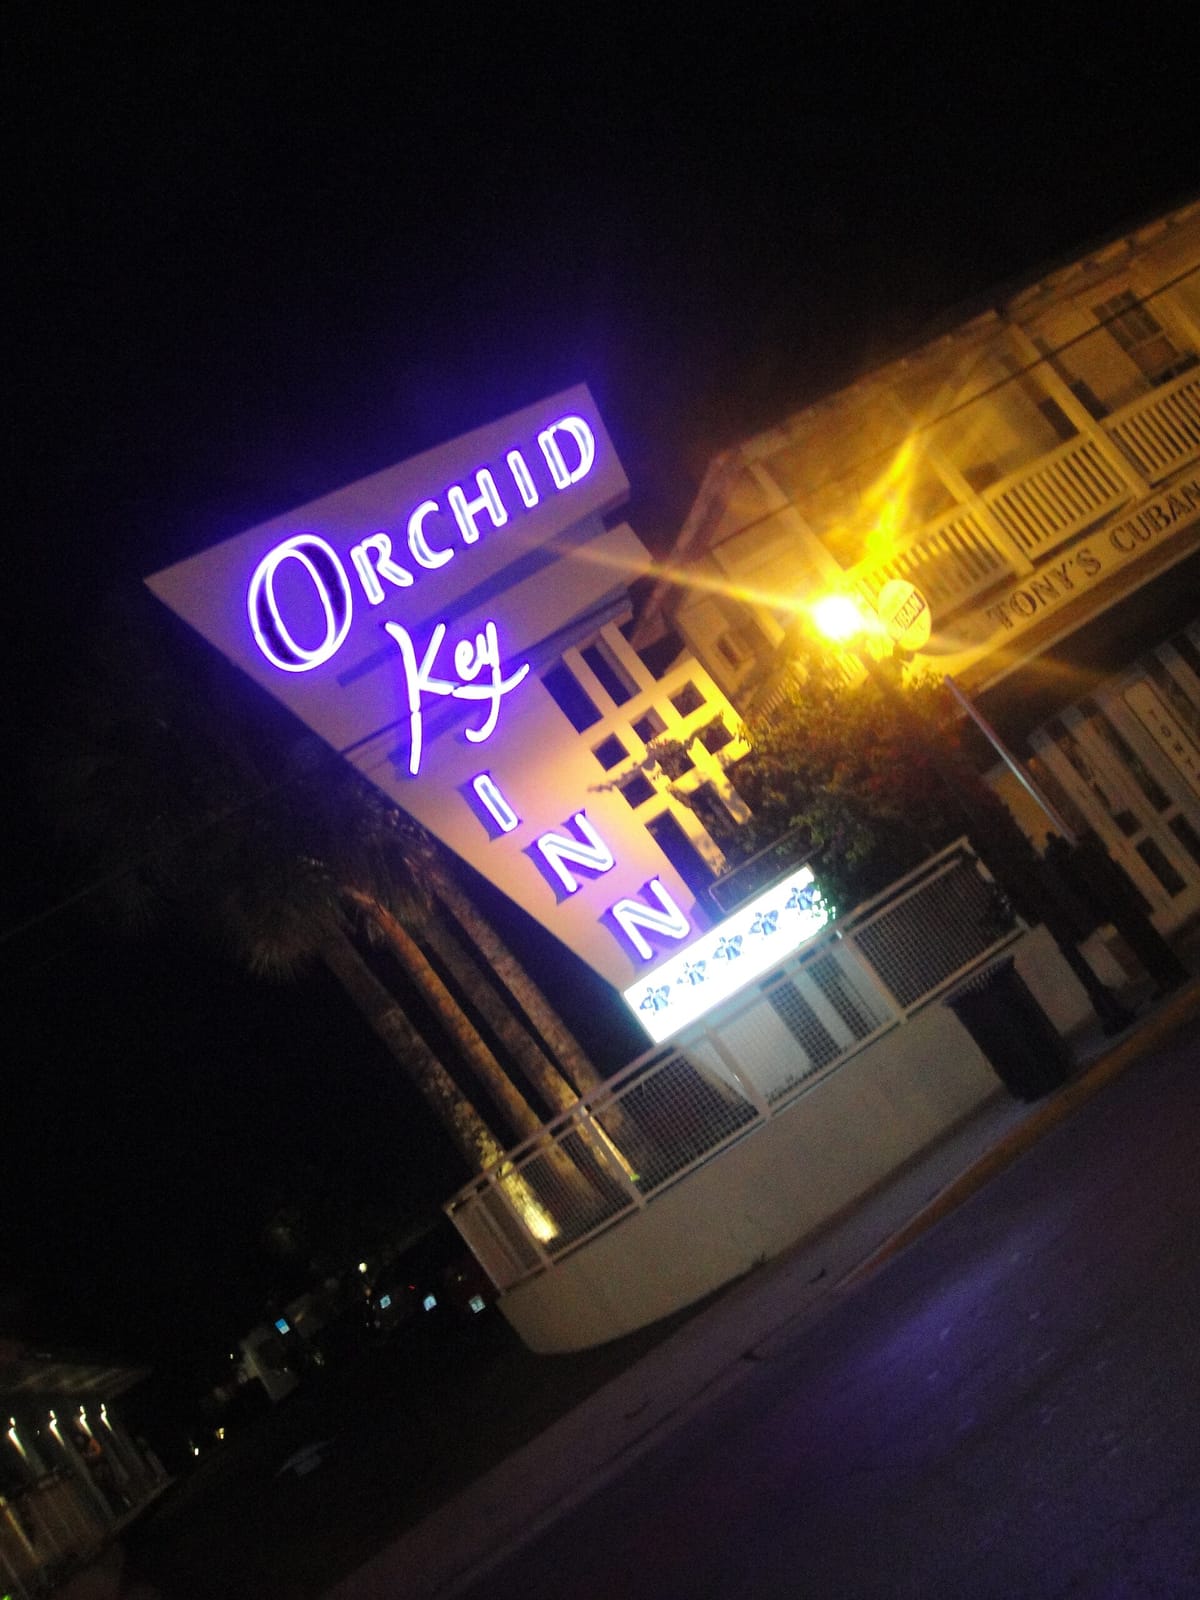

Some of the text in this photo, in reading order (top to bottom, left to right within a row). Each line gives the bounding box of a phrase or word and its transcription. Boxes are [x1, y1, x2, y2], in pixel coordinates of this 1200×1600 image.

[247, 414, 597, 673] ORCHID
[986, 548, 1102, 630] TONY'S
[385, 620, 529, 775] Key
